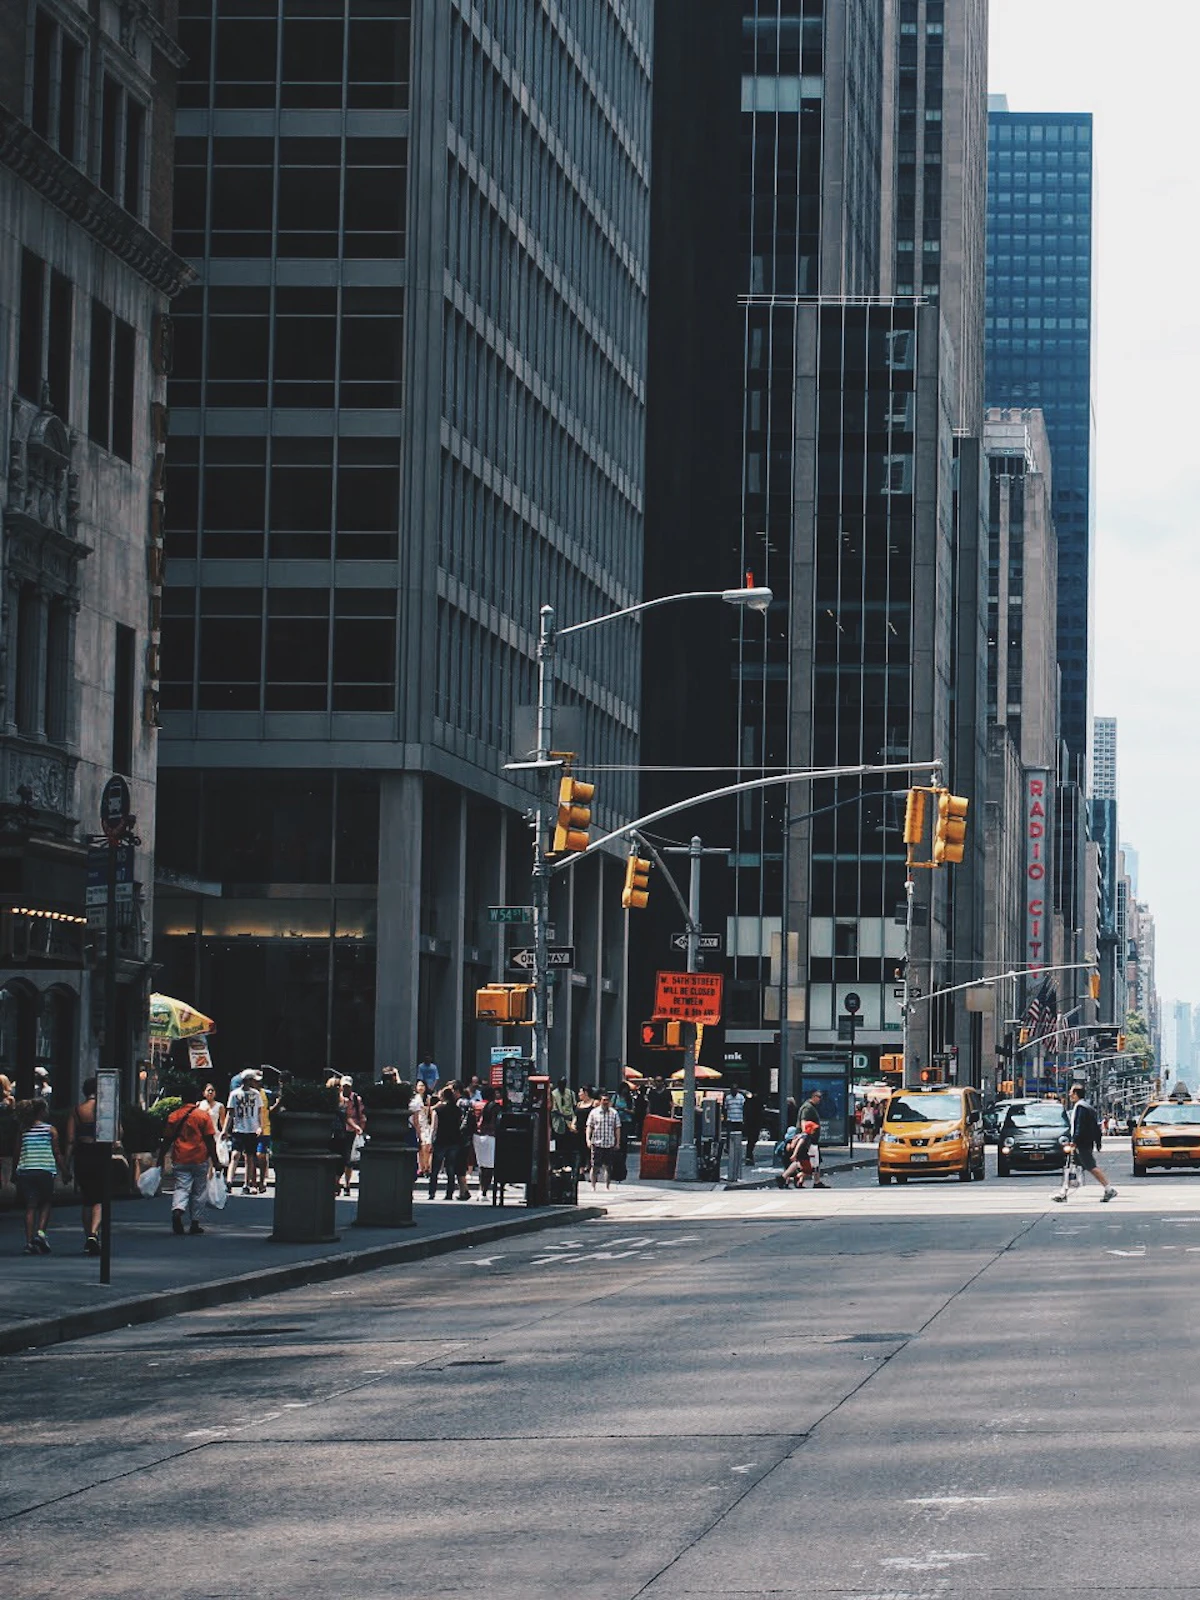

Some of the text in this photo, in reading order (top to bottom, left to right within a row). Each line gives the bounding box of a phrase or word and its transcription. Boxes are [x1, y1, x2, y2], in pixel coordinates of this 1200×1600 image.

[1028, 780, 1044, 979] RADIO CITY
[490, 909, 499, 921] W
[500, 909, 512, 921] 54
[692, 977, 720, 986] STREET
[690, 987, 716, 996] CLOSED
[673, 996, 703, 1006] BETWEEN
